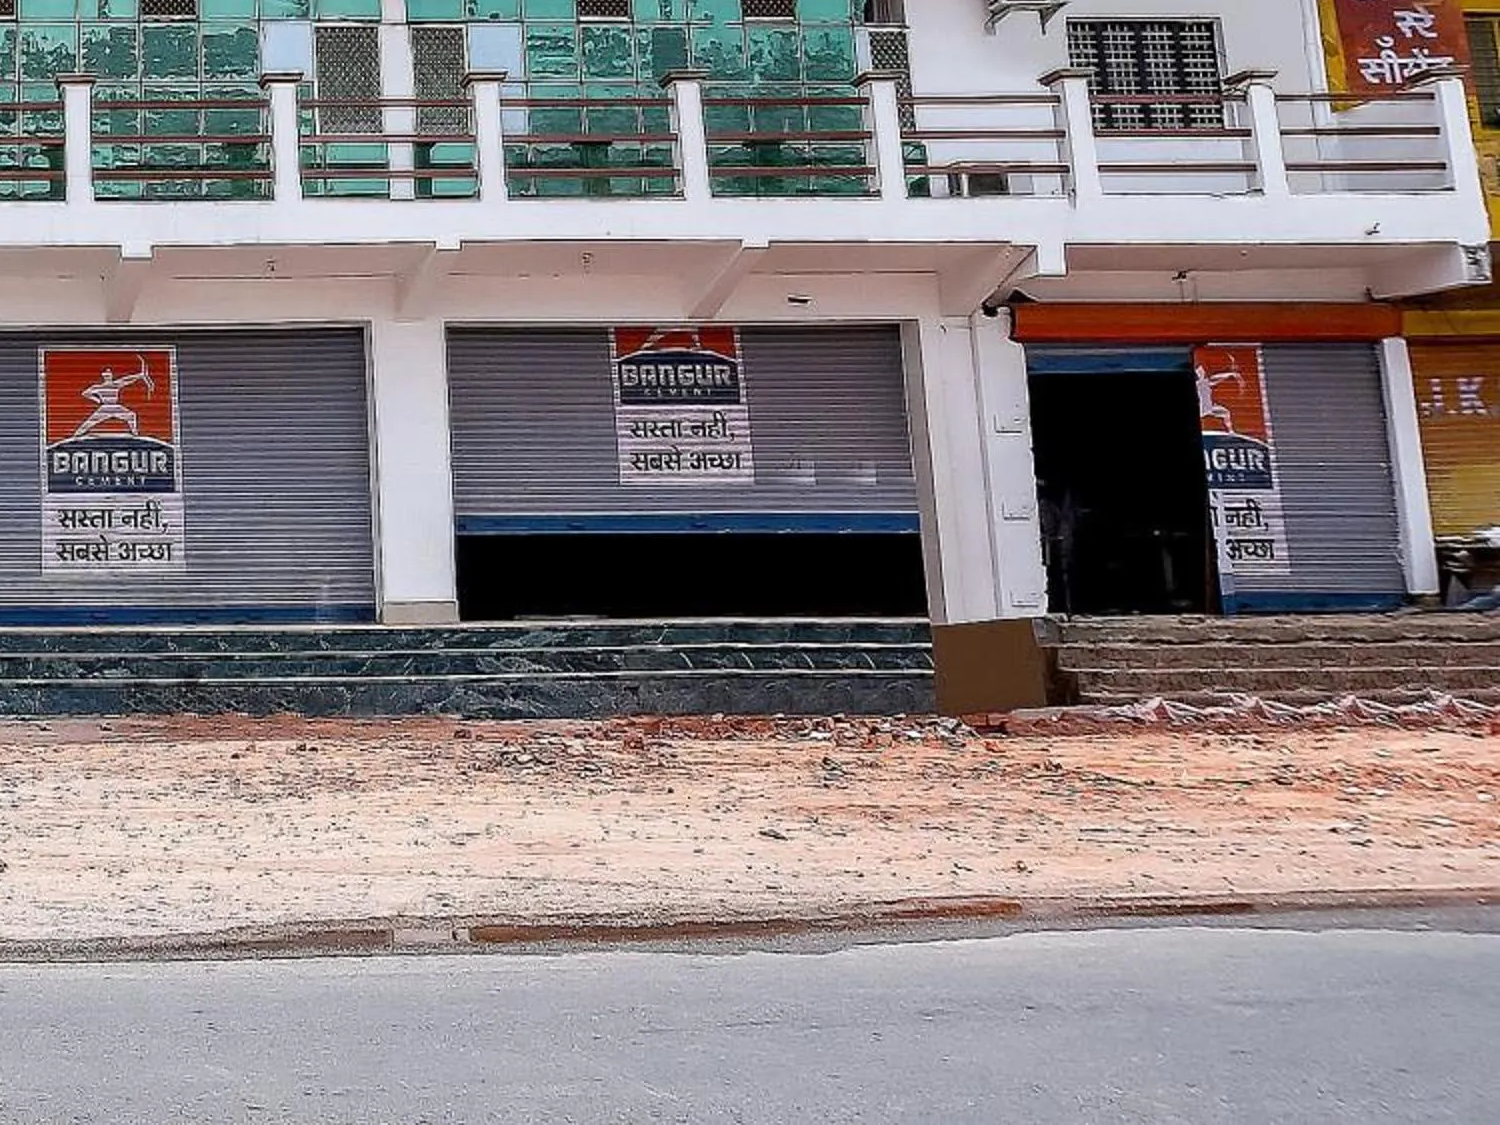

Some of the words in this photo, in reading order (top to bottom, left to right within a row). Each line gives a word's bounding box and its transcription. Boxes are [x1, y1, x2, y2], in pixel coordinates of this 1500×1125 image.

[621, 364, 731, 386] BANGUR
[630, 420, 682, 439] सस्ता
[53, 452, 168, 474] BANGUR
[630, 445, 683, 471] सबसे
[689, 452, 741, 471] अच्छा
[58, 508, 114, 528] सस्ता
[56, 534, 110, 561] सबसे
[118, 542, 175, 561] अच्छा
